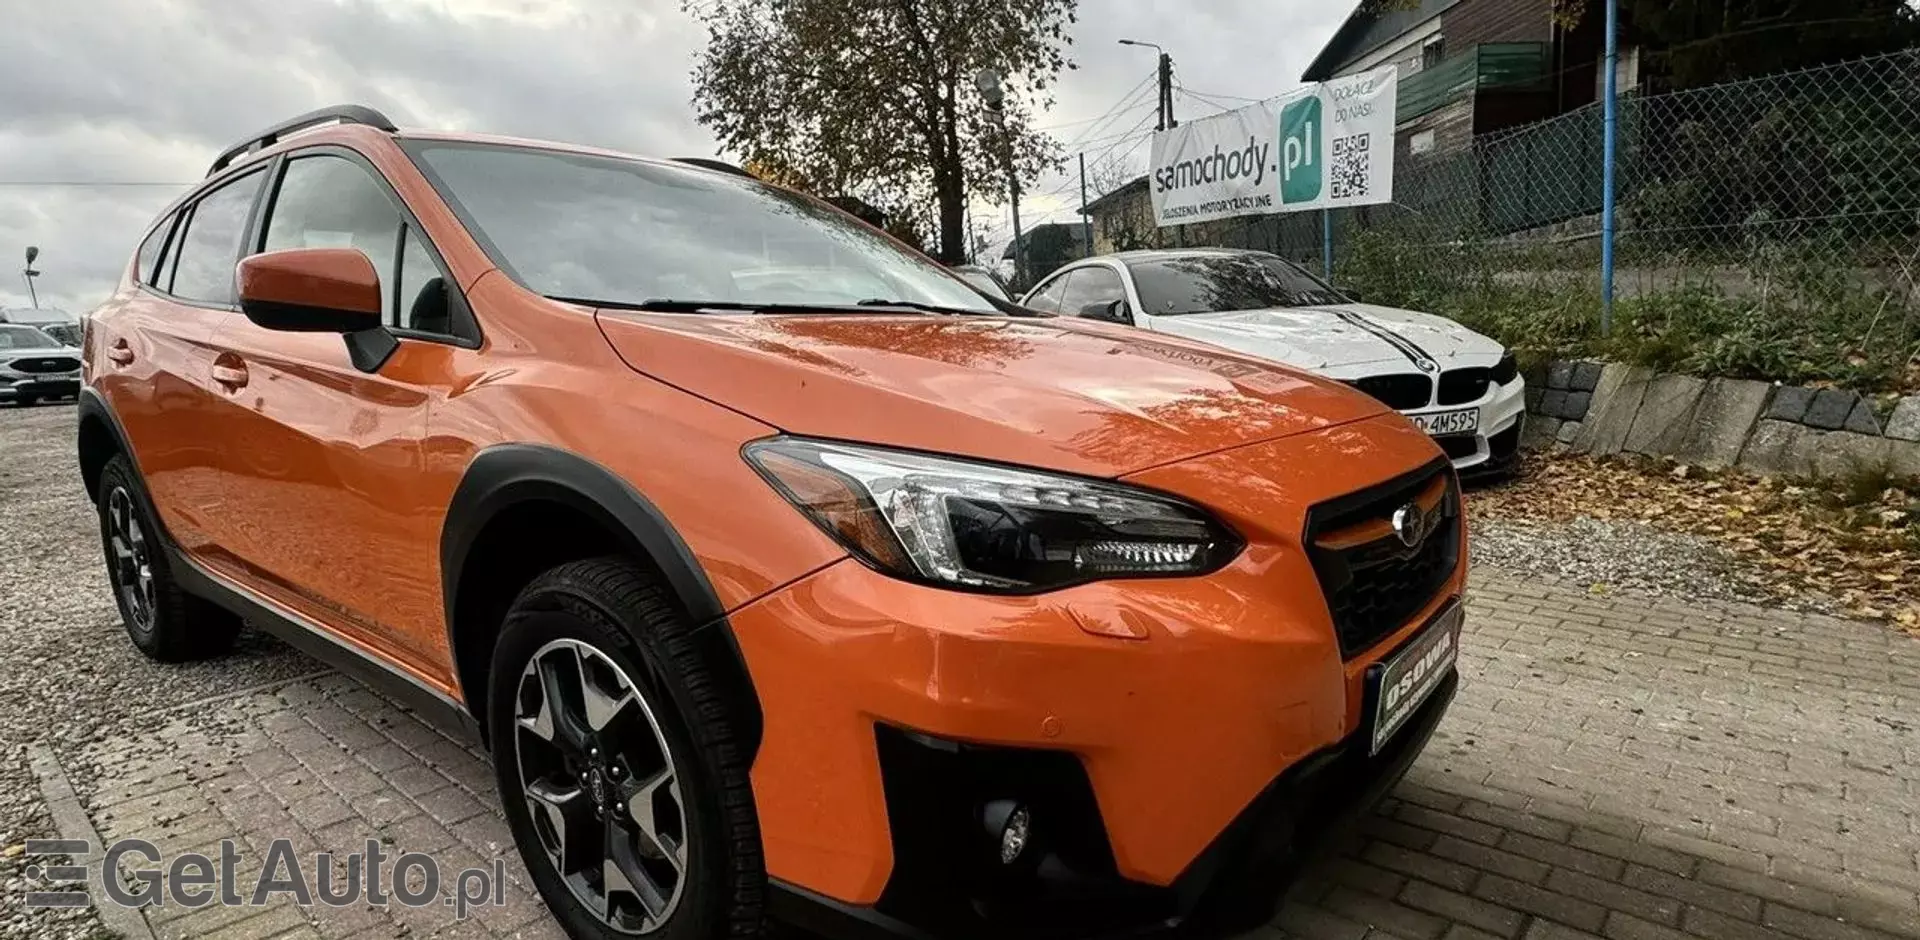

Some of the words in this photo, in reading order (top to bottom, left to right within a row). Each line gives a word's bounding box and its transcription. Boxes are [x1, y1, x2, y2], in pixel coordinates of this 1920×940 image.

[1335, 108, 1347, 123] DO
[1200, 194, 1272, 213] MOTORYZACYJNE
[1430, 411, 1475, 433] 4M595
[1386, 631, 1451, 711] OSOWA
